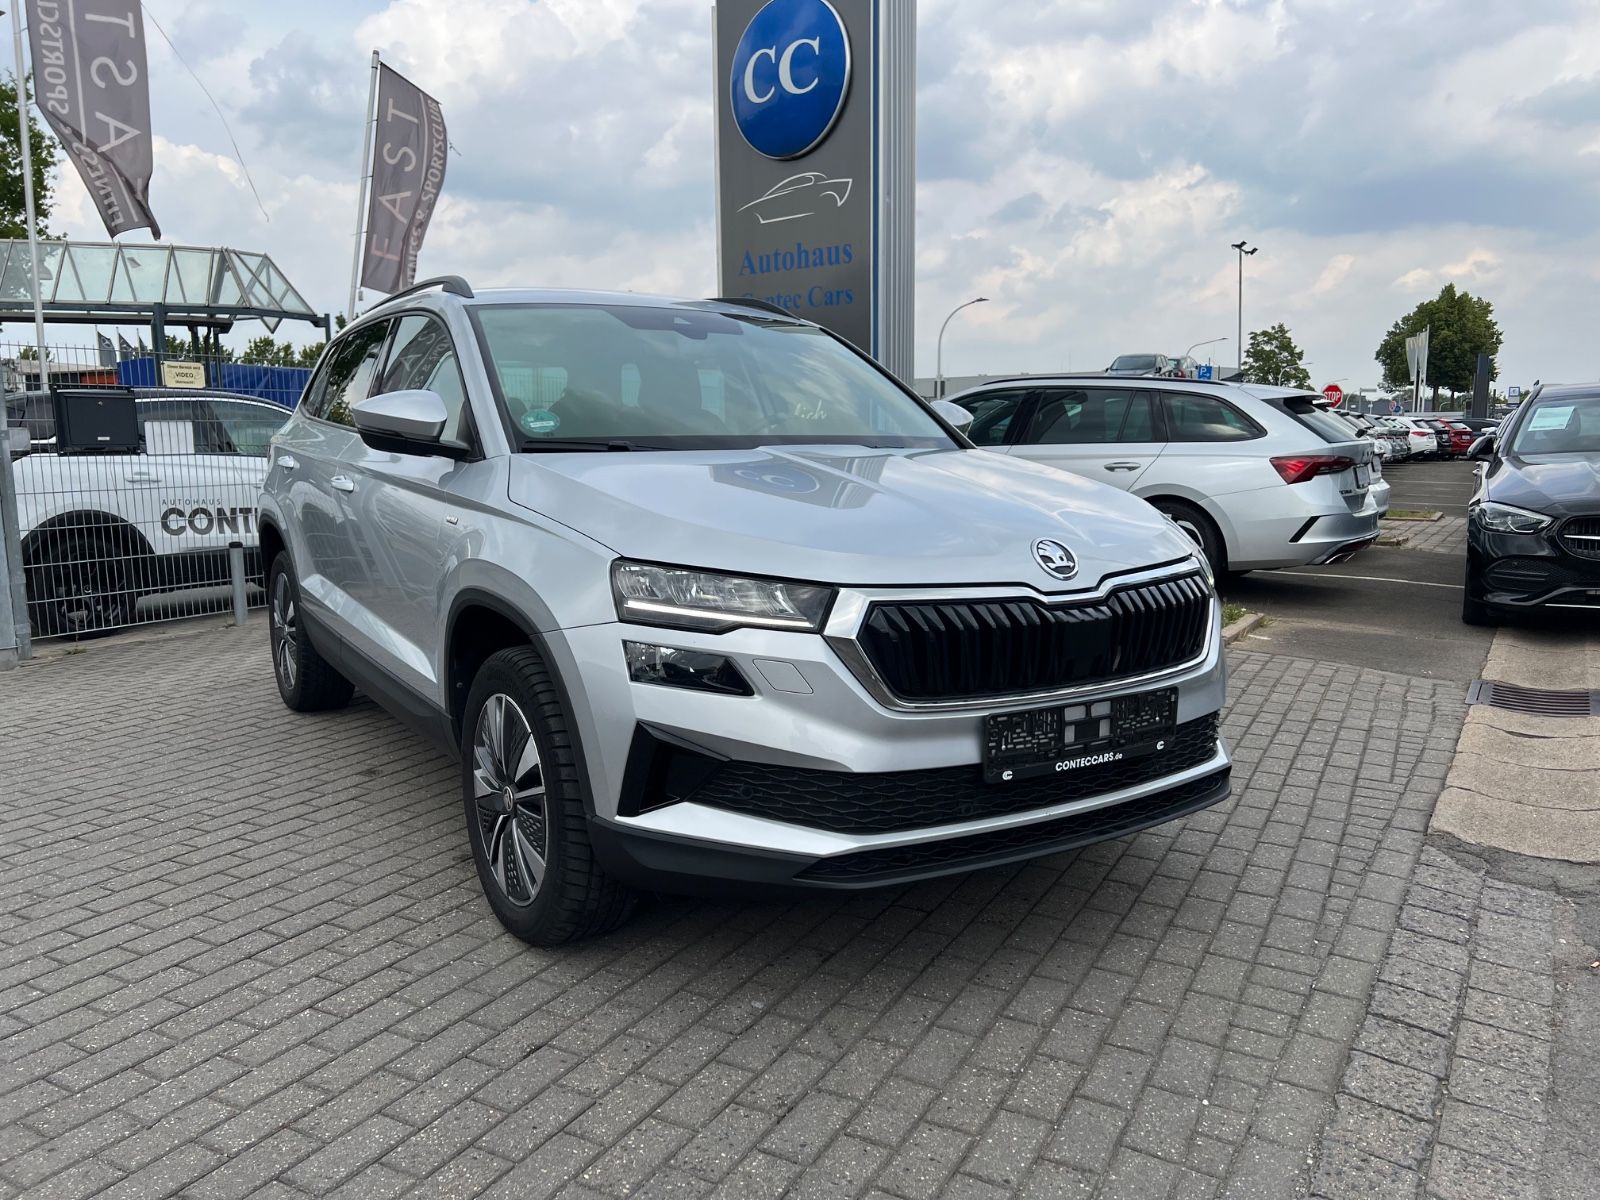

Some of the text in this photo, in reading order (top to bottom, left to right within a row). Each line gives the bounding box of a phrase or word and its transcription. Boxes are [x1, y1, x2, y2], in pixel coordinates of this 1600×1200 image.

[743, 36, 820, 104] CC
[421, 100, 445, 204] SPORTSCLUB
[370, 97, 419, 261] FAST
[739, 243, 853, 275] Autohaus
[807, 285, 853, 307] Cars
[1323, 391, 1341, 402] STOP
[162, 498, 222, 506] AUTOHAUS
[1055, 752, 1123, 771] CONTECCARS.de
